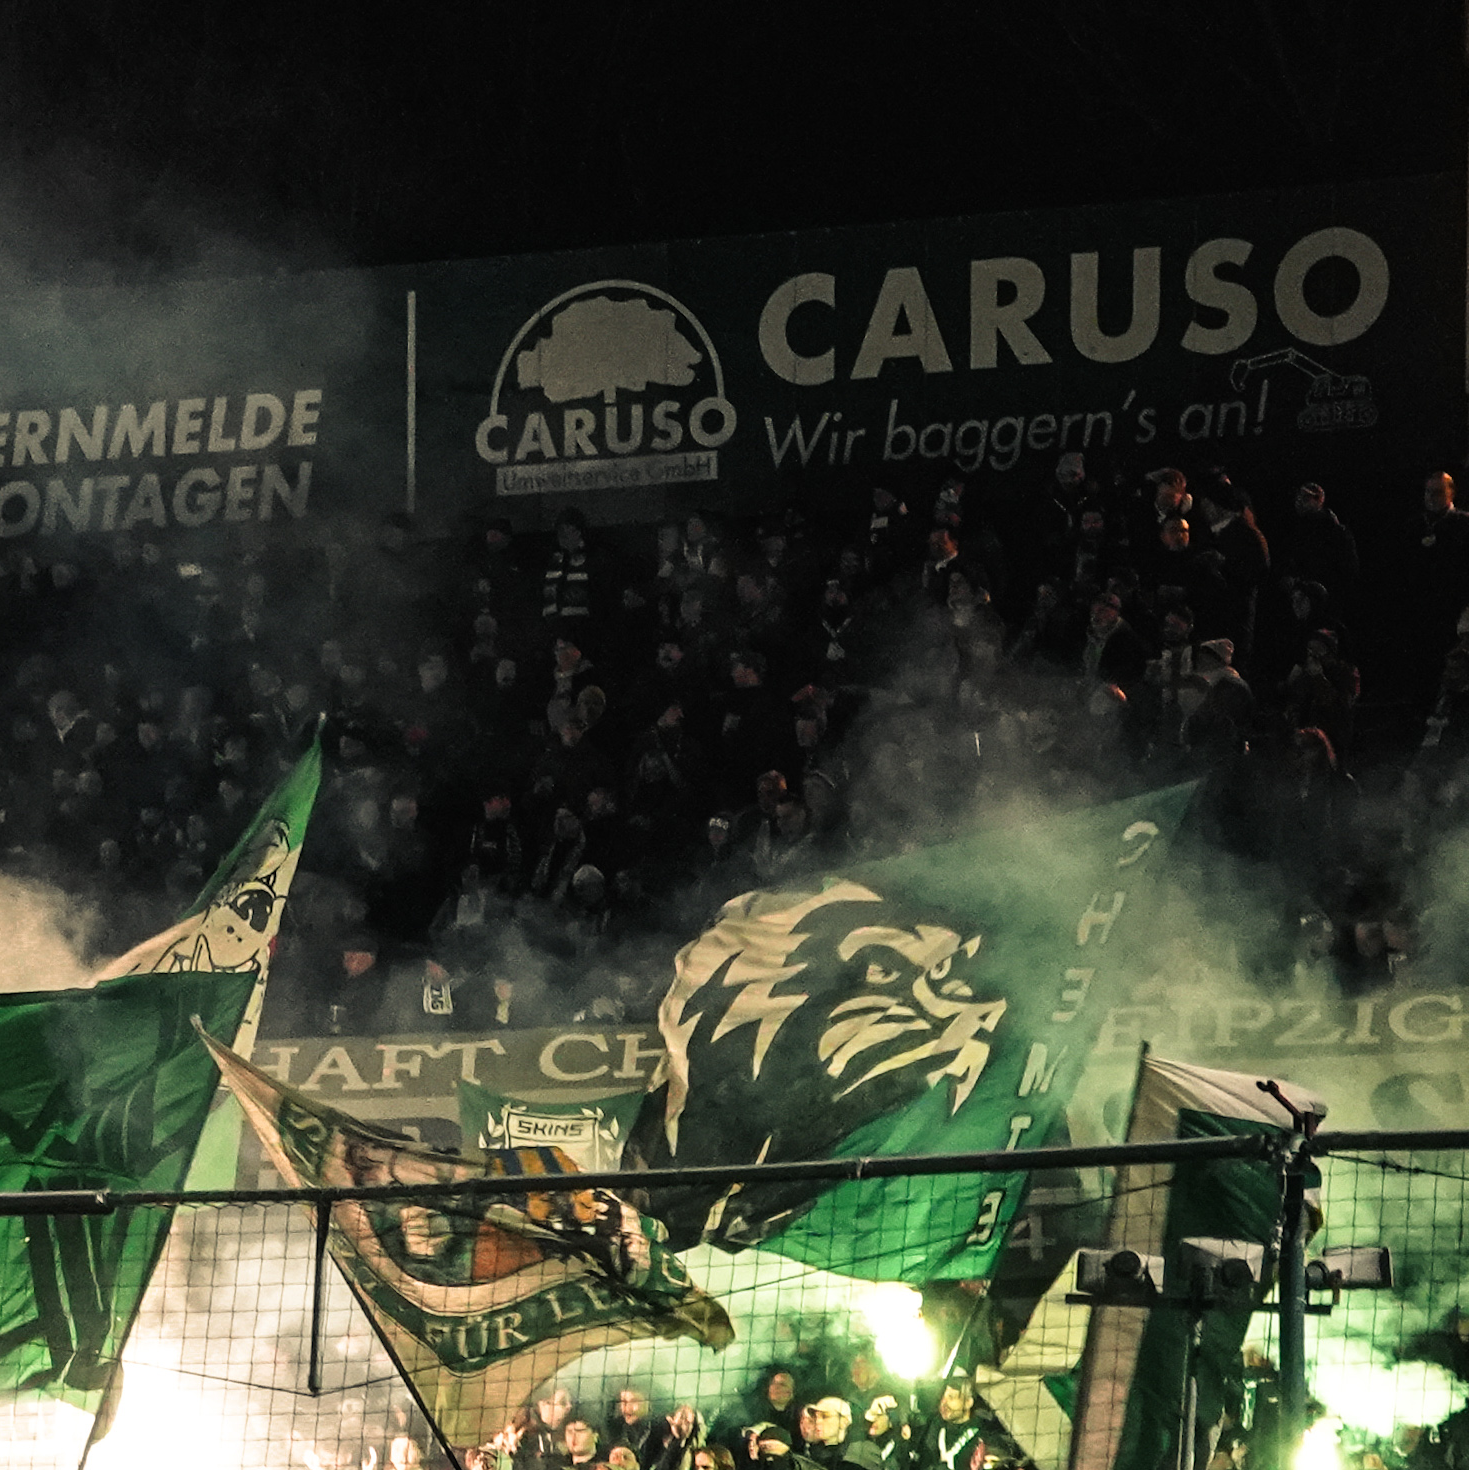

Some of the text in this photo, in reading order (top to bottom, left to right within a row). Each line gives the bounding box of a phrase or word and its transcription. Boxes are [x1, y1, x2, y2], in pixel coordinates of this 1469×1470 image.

[758, 227, 1391, 386] CARUSO
[475, 396, 737, 464] CARUSO
[763, 379, 1269, 471] Wir baggern's an!
[539, 1033, 667, 1081] CH
[517, 1119, 585, 1138] SKINS
